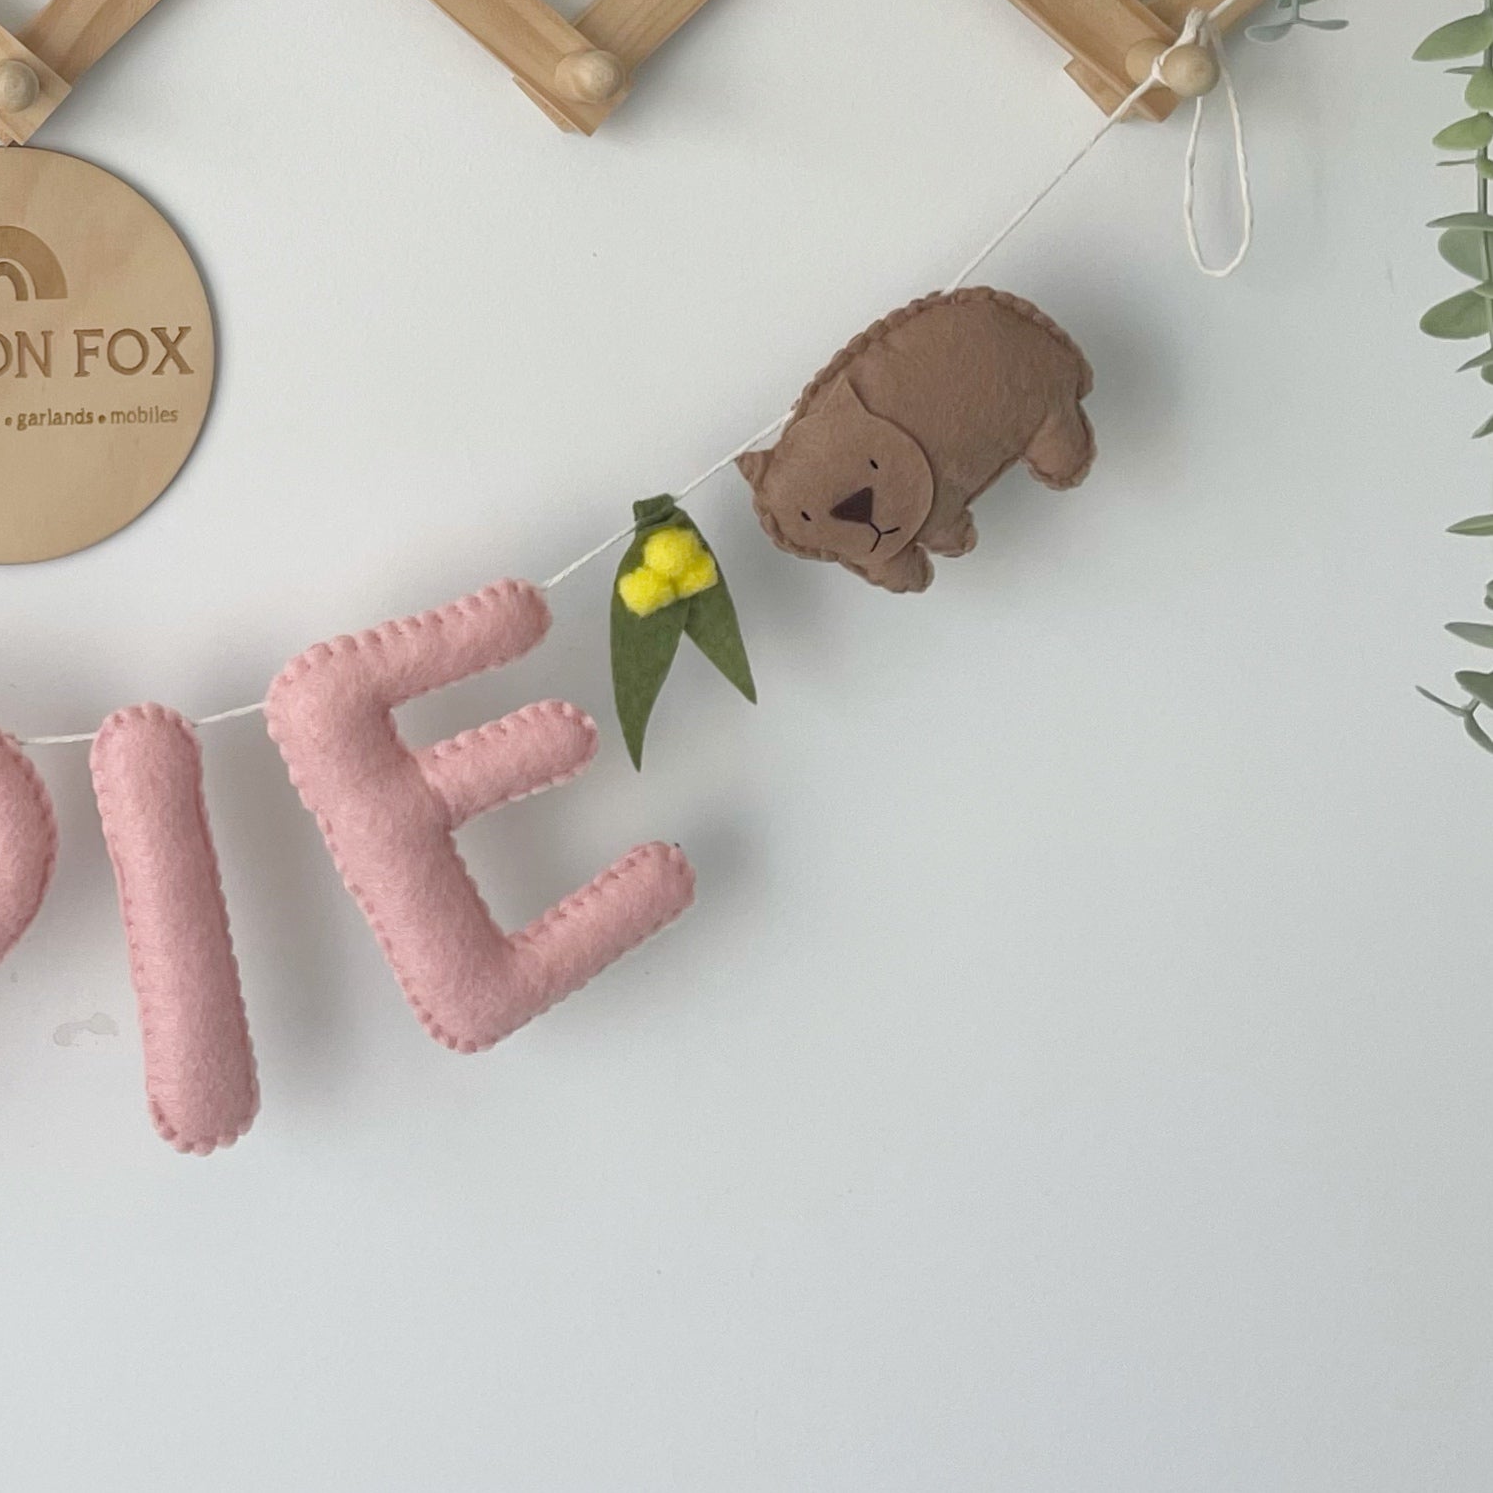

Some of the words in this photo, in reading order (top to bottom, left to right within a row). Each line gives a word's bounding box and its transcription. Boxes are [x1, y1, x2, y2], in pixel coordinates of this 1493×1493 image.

[73, 325, 195, 377] FOX
[16, 407, 94, 431] garlands
[109, 405, 179, 425] mobiles
